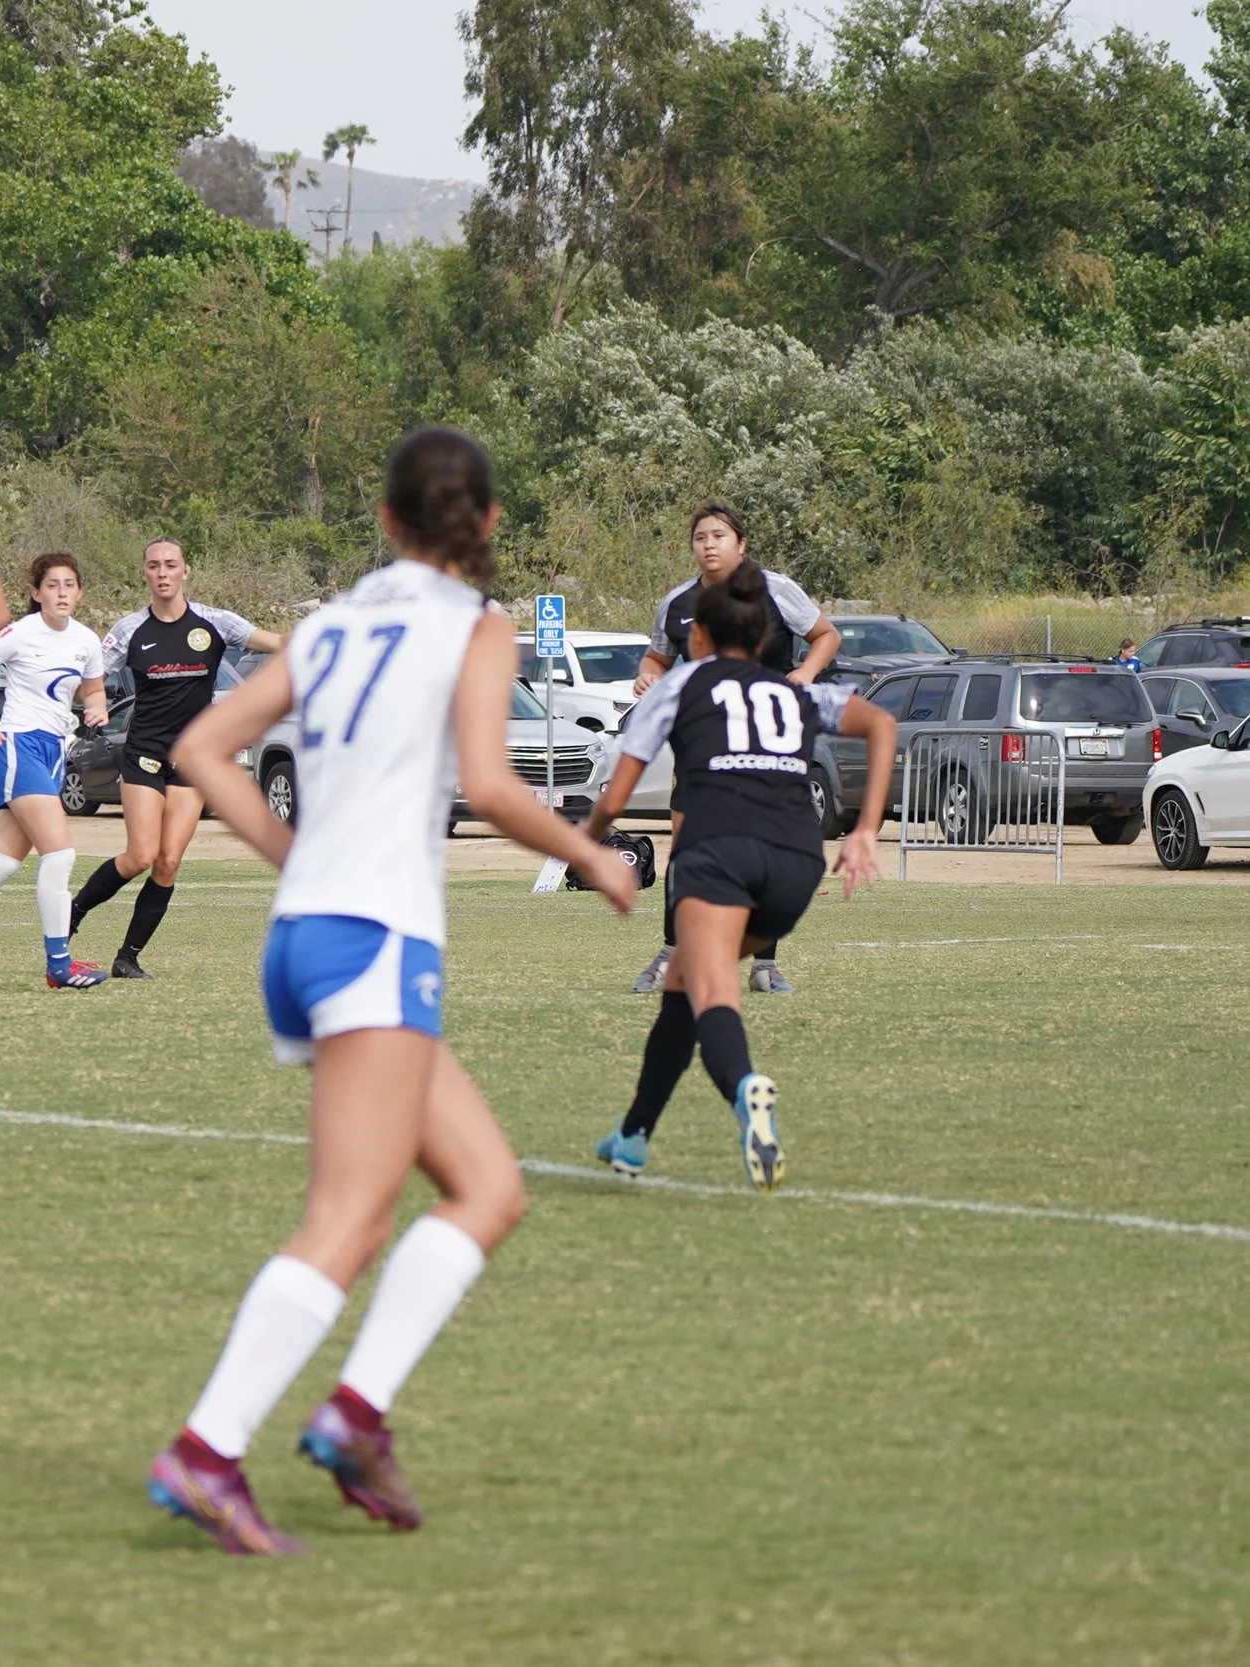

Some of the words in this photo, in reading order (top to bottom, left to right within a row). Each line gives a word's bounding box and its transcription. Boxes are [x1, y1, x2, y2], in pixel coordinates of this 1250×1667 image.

[538, 619, 563, 629] PARKING
[543, 629, 559, 638] ONLY
[300, 624, 407, 749] 27
[711, 679, 804, 754] 10
